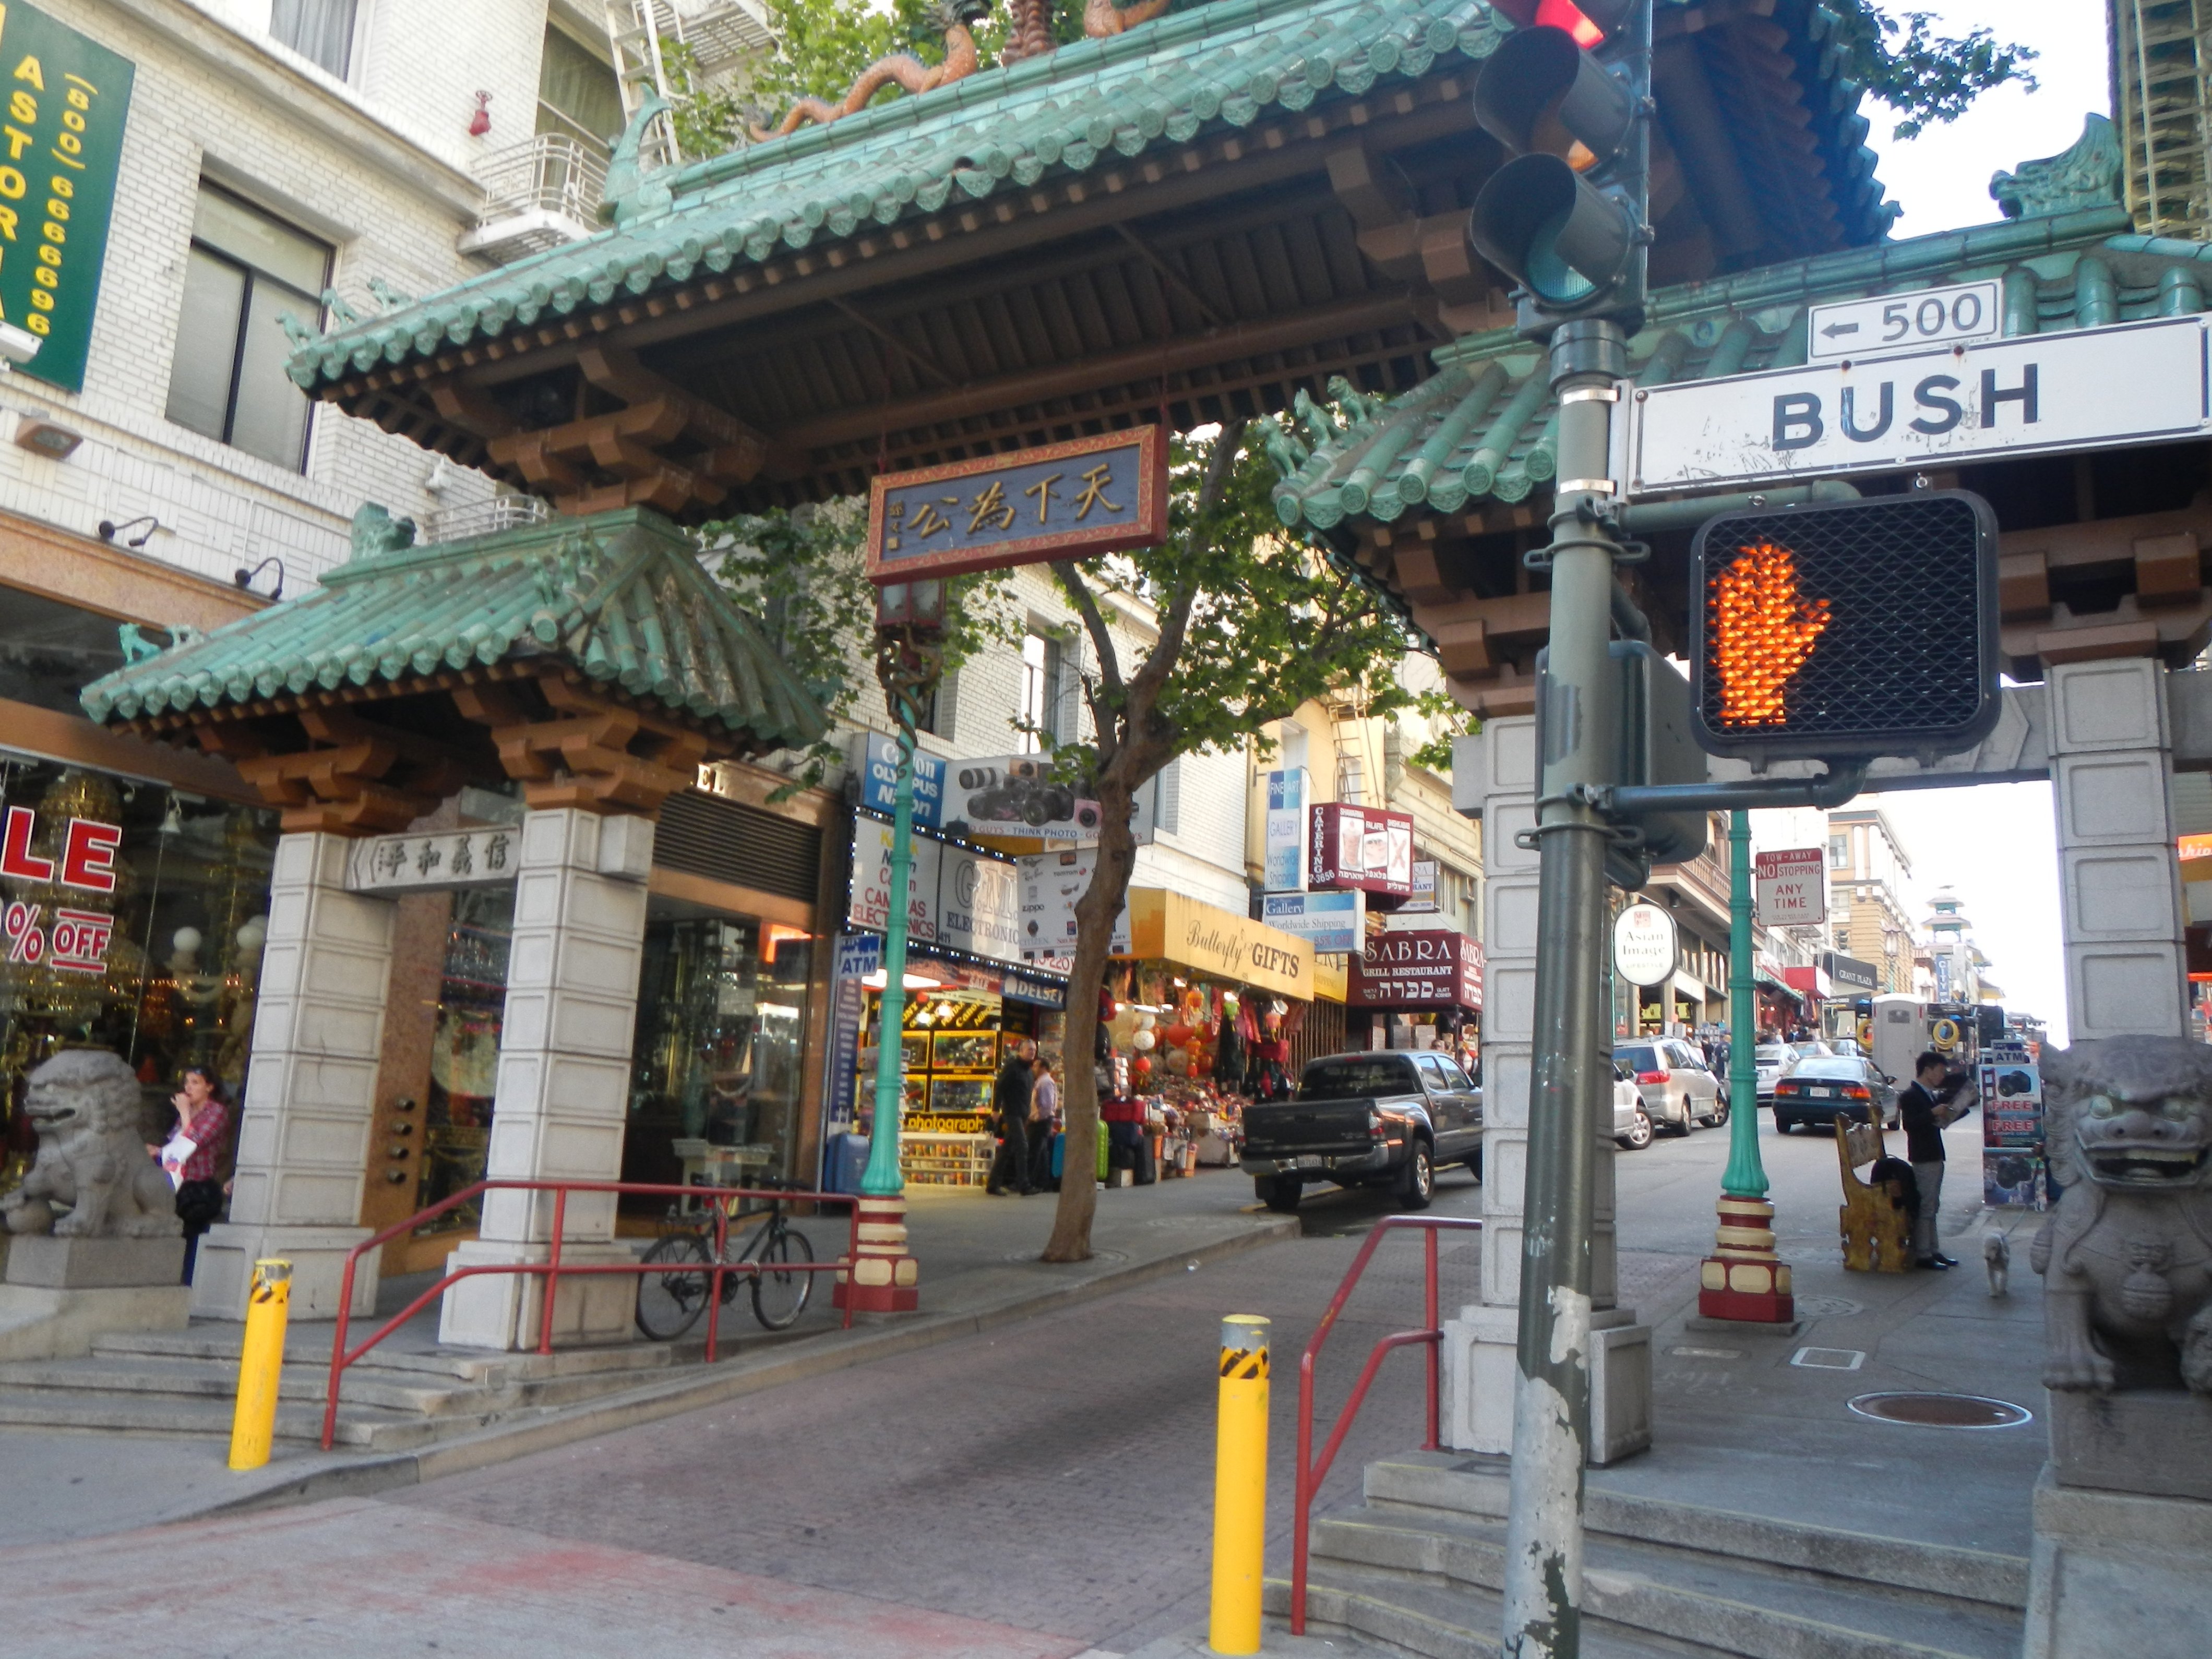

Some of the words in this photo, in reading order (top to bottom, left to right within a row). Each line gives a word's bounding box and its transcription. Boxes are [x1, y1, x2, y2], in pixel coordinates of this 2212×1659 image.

[0, 55, 44, 320] ASTOR
[1882, 293, 1982, 342] 500
[1773, 363, 2038, 451] BUSH
[872, 763, 938, 798] OLYPUS
[1270, 782, 1284, 795] FINE
[1287, 780, 1300, 794] ART
[877, 784, 930, 818] Nion
[1012, 826, 1042, 836] THINK
[1044, 828, 1078, 839] PHOTO
[1270, 820, 1298, 836] GALLERY
[1365, 820, 1385, 831] FALAFEL
[1313, 807, 1324, 873] CATERING
[1267, 854, 1299, 867] Worldwide
[1766, 851, 1812, 862] TOW-AWAY
[1269, 871, 1296, 886] Shipping
[1758, 864, 1775, 879] NO
[1778, 864, 1821, 877] STOPPING
[1776, 883, 1803, 895] ANY
[864, 887, 926, 918] CAMAS
[1266, 903, 1304, 915] Gallery
[1774, 897, 1807, 909] TIME
[852, 903, 936, 939] ELECTNICS
[947, 911, 1019, 945] ELECTRONIC
[1269, 920, 1309, 930] Worldwide
[1312, 919, 1346, 931] Shipping
[52, 921, 112, 959] OFF
[1625, 931, 1664, 942] Asian
[1187, 919, 1242, 973] Butterfly
[1252, 942, 1300, 979] GIFTS
[1363, 940, 1453, 963] SABRA
[1461, 939, 1484, 969] SABRA
[1623, 945, 1665, 957] Image
[842, 957, 877, 974] ATM
[1362, 968, 1390, 978] GRILL
[1392, 966, 1454, 977] RESTAURANT
[1838, 969, 1856, 981] GRANT
[1856, 974, 1873, 986] PLAZA
[1938, 960, 1947, 990] CITY
[1017, 981, 1065, 1004] DELSEY
[1996, 1052, 2024, 1061] ATM
[1992, 1100, 2033, 1111] FREE
[908, 1113, 984, 1133] photograph
[1992, 1120, 2035, 1132] FREE
